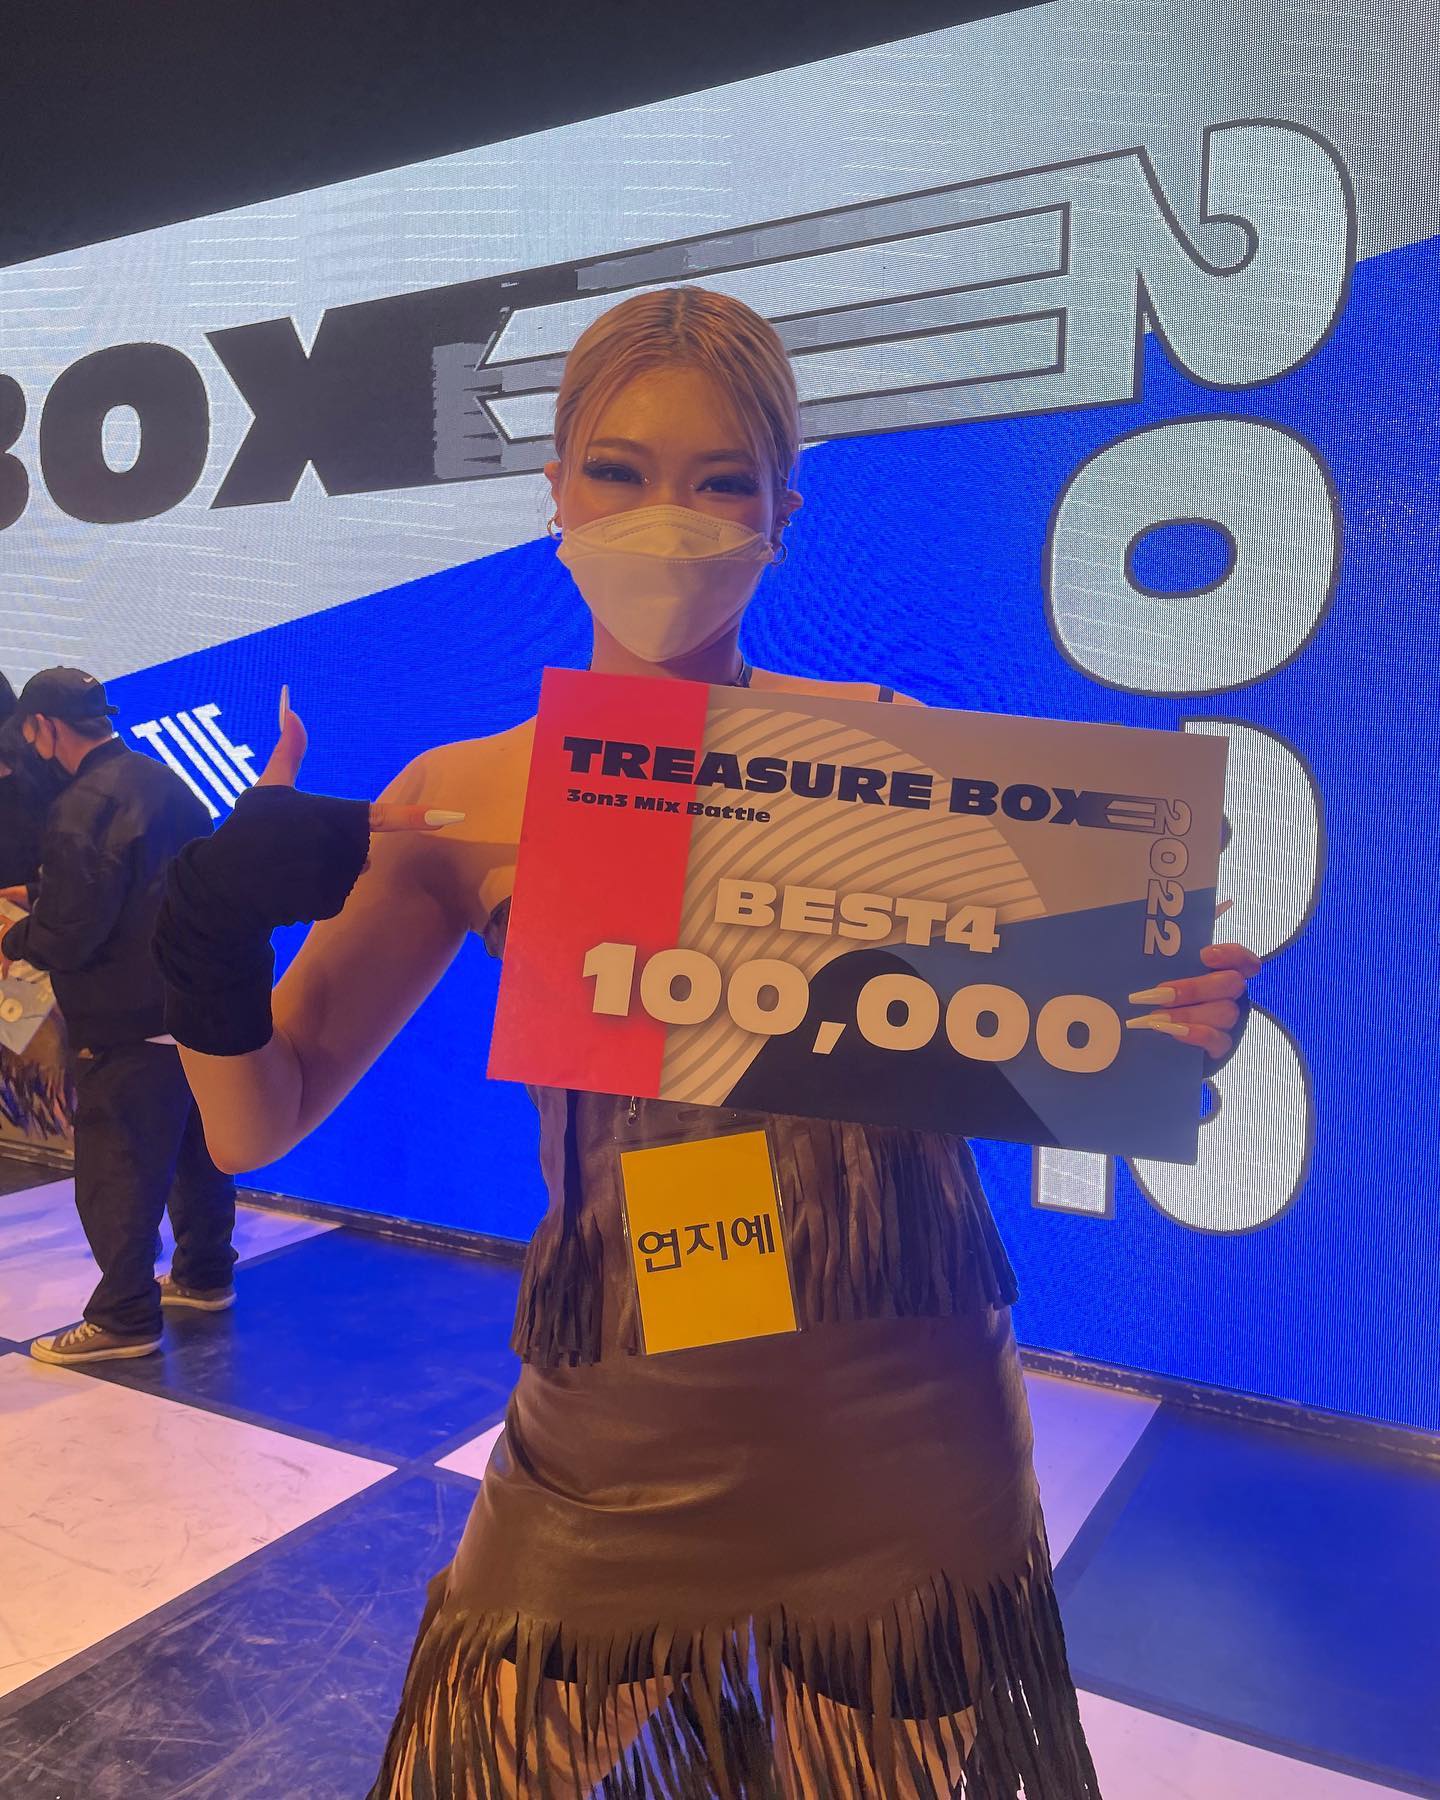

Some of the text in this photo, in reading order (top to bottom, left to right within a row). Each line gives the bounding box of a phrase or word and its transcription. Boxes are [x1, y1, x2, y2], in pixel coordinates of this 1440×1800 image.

[562, 736, 1112, 831] TREASURE BOX
[566, 788, 771, 823] 3on3 Mix Battle
[714, 877, 1001, 954] BEST4
[1142, 797, 1193, 957] 2022
[581, 941, 1123, 1074] 100,000
[637, 1213, 776, 1273] 연지예
